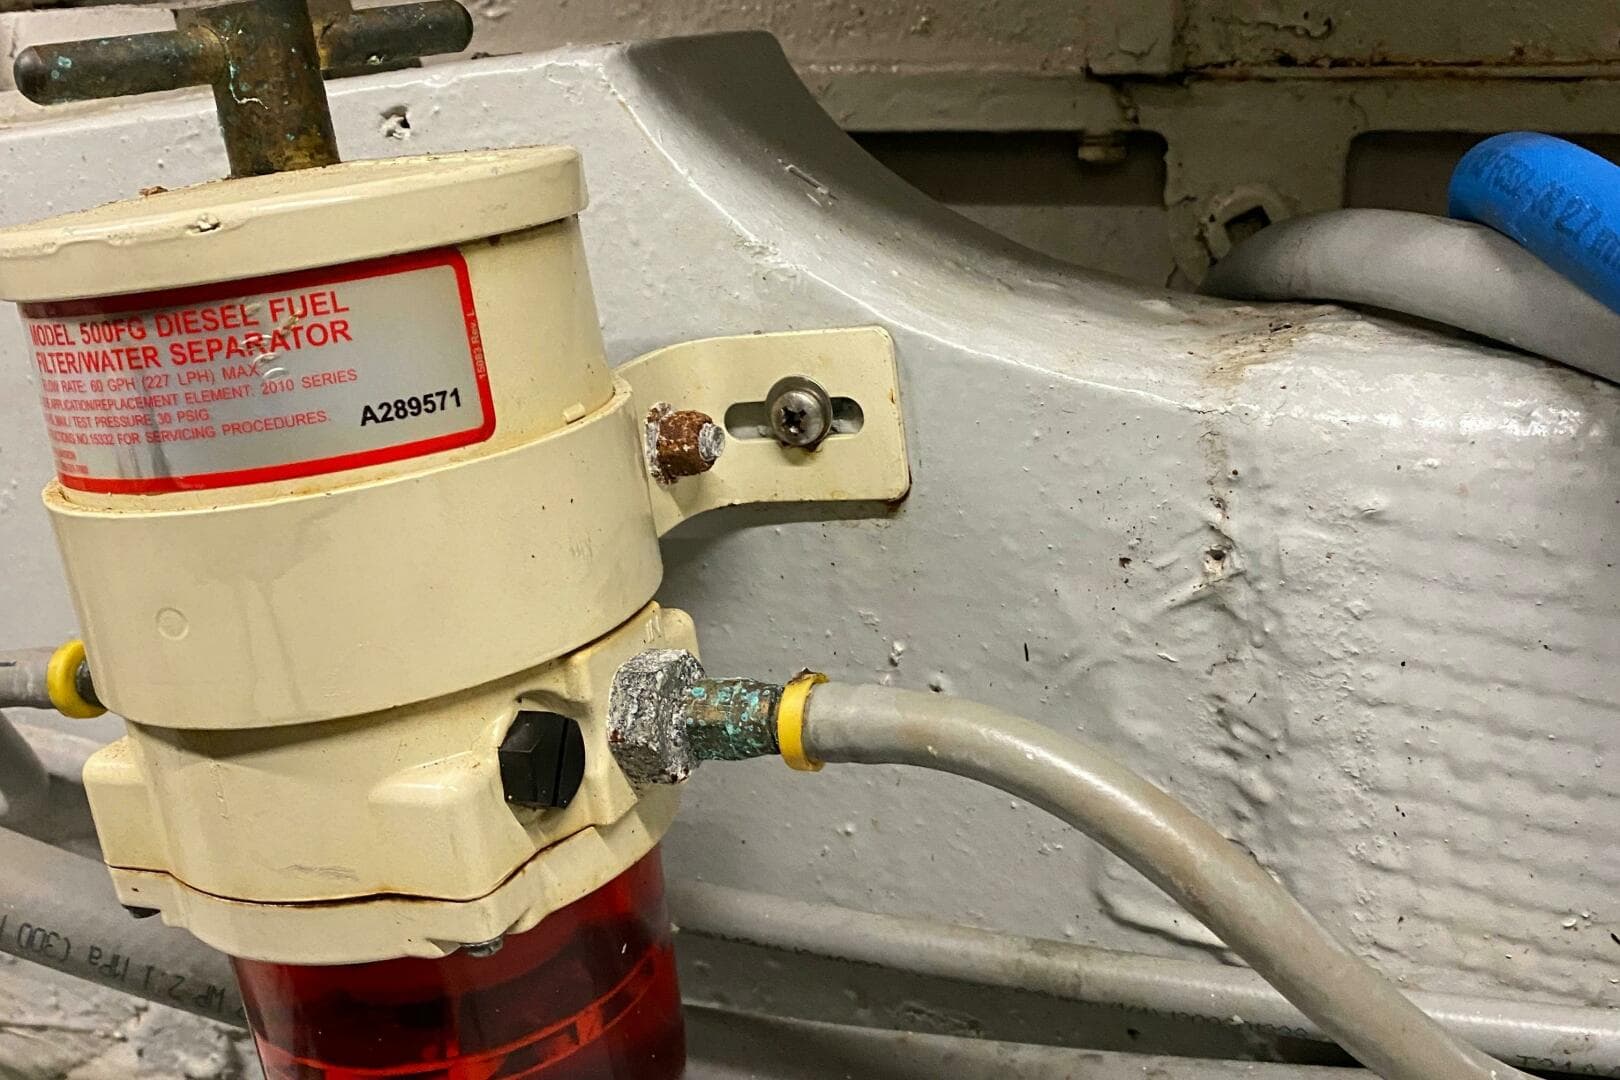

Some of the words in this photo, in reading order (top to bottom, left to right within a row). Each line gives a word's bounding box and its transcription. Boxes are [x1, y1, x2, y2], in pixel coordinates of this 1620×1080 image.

[30, 323, 76, 346] MODEL
[80, 316, 147, 345] 500FG
[154, 303, 260, 338] DIESEL
[268, 290, 350, 323] FUEL
[35, 345, 162, 375] FILTER/WATER
[168, 319, 353, 367] SEPARATOR
[90, 379, 103, 392] 60
[108, 377, 136, 392] GPH
[142, 373, 169, 391] (227
[177, 367, 215, 386] LPH)
[262, 378, 295, 395] 2010
[301, 369, 358, 389] SERIES
[72, 416, 91, 428] TEST
[157, 412, 172, 425] 30
[177, 408, 209, 423] PSIG
[360, 386, 461, 427] A289571
[118, 431, 140, 445] FOR
[145, 426, 216, 443] SERVICING
[222, 410, 332, 436] PROCEDURES.
